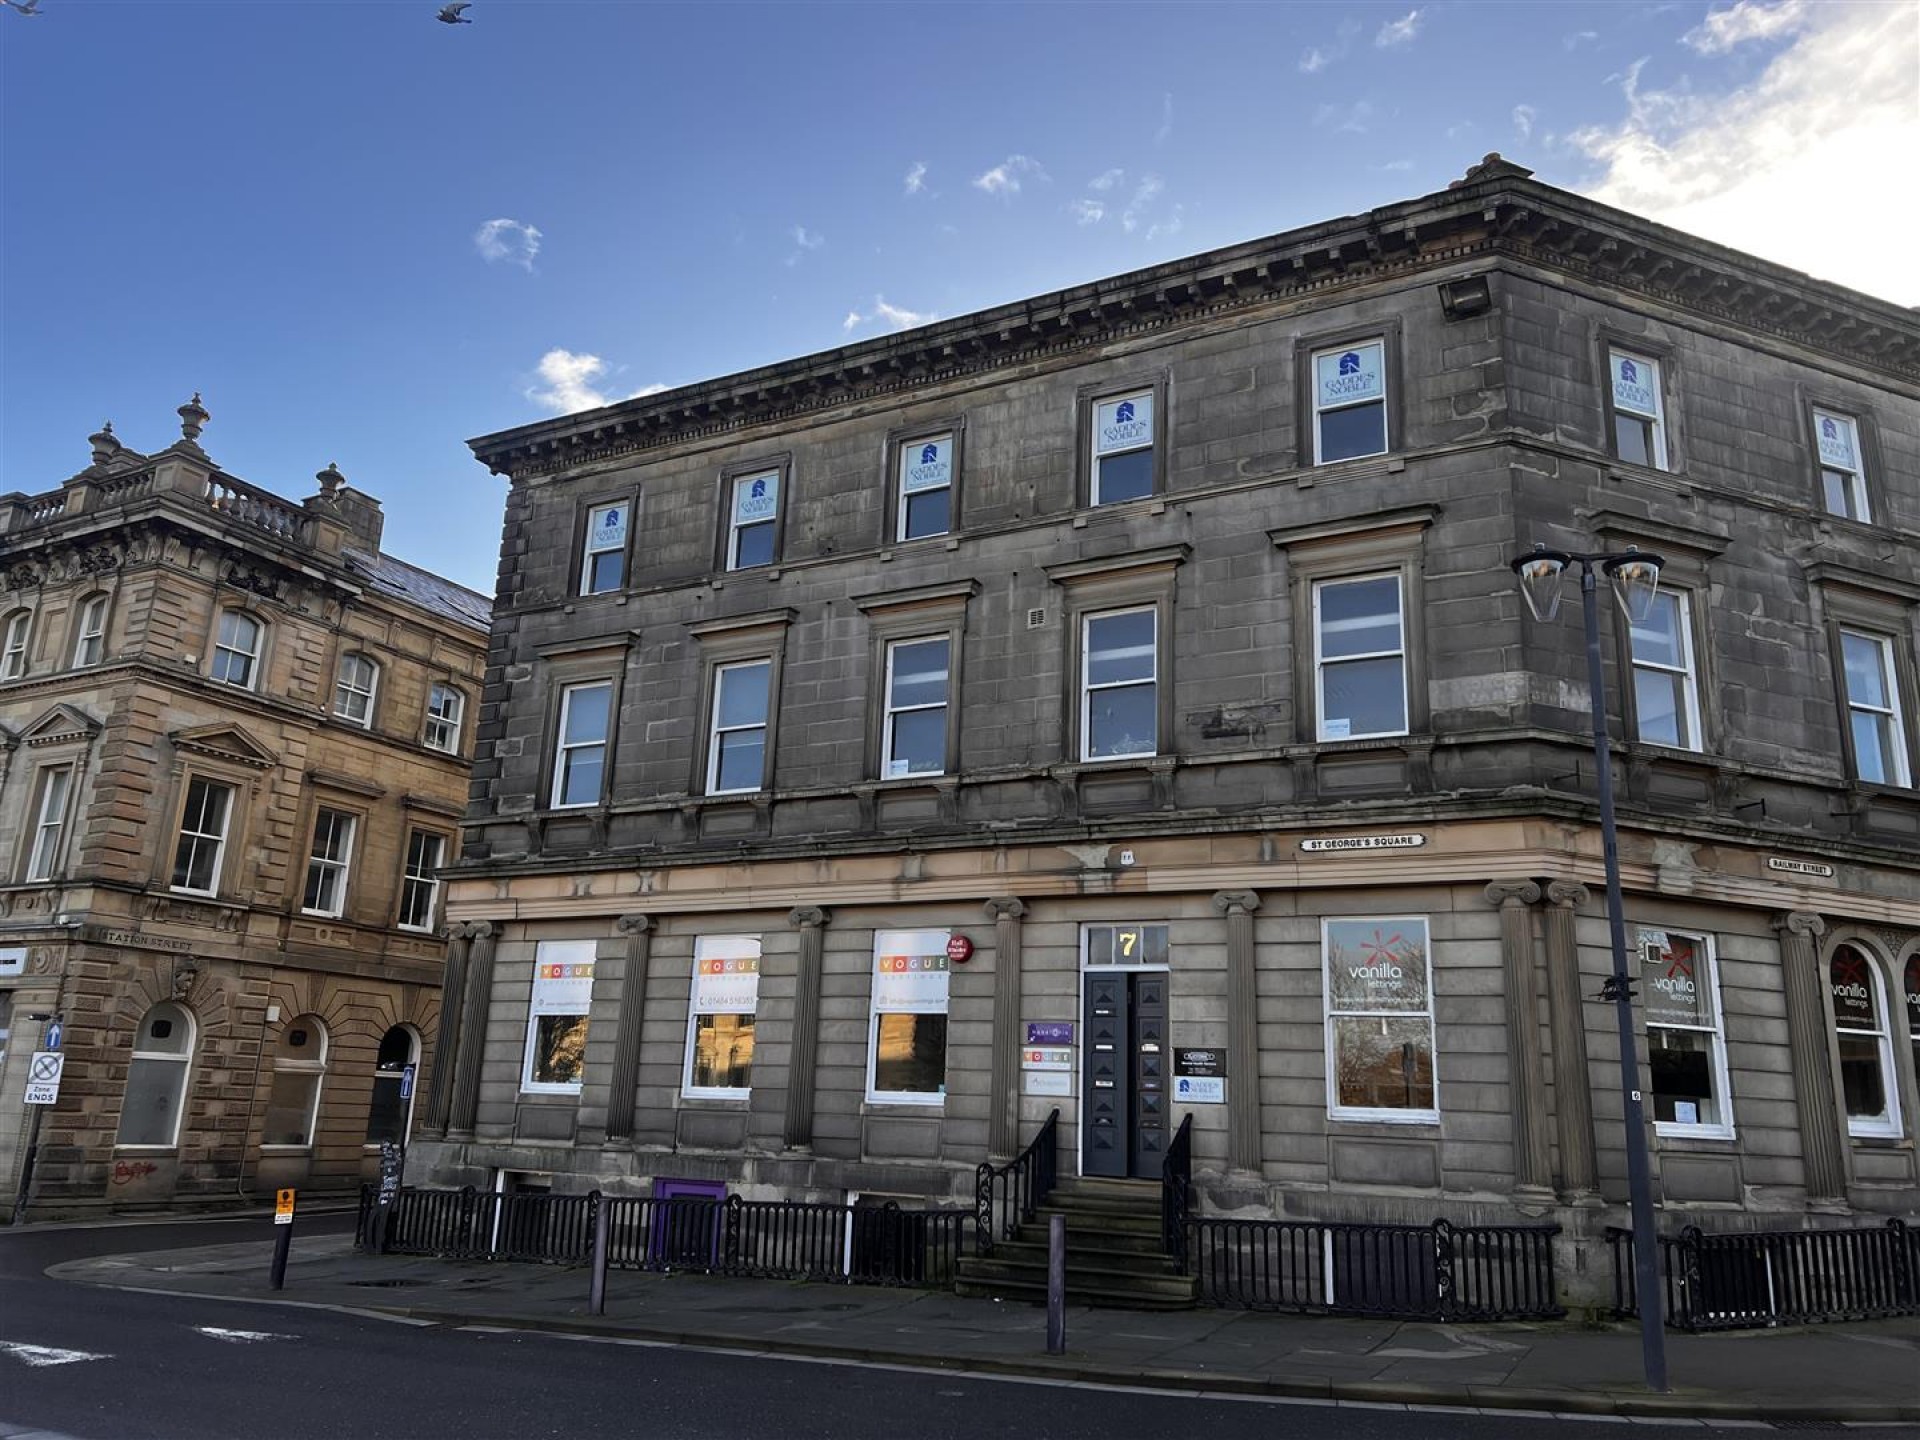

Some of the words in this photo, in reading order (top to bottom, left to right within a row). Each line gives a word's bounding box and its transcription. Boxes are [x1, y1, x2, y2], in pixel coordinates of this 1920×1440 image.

[1325, 371, 1375, 389] GADDES
[1328, 380, 1370, 395] NOBLE
[1311, 840, 1322, 849] ST
[1325, 838, 1370, 848] GEORGE'S
[1374, 836, 1413, 846] SQUARE
[1773, 859, 1801, 870] RAILWAY
[1803, 863, 1826, 874] STREET
[102, 931, 148, 945] STATION
[151, 938, 192, 950] STREET
[1119, 932, 1137, 956] 7
[701, 960, 758, 972] VOGUE
[883, 957, 945, 969] VOGUE
[1348, 962, 1402, 978] vanilla
[542, 966, 593, 977] VOGUE
[1654, 976, 1696, 993] vanilla
[1831, 982, 1867, 998] vanilla
[28, 1093, 54, 1101] ENDS
